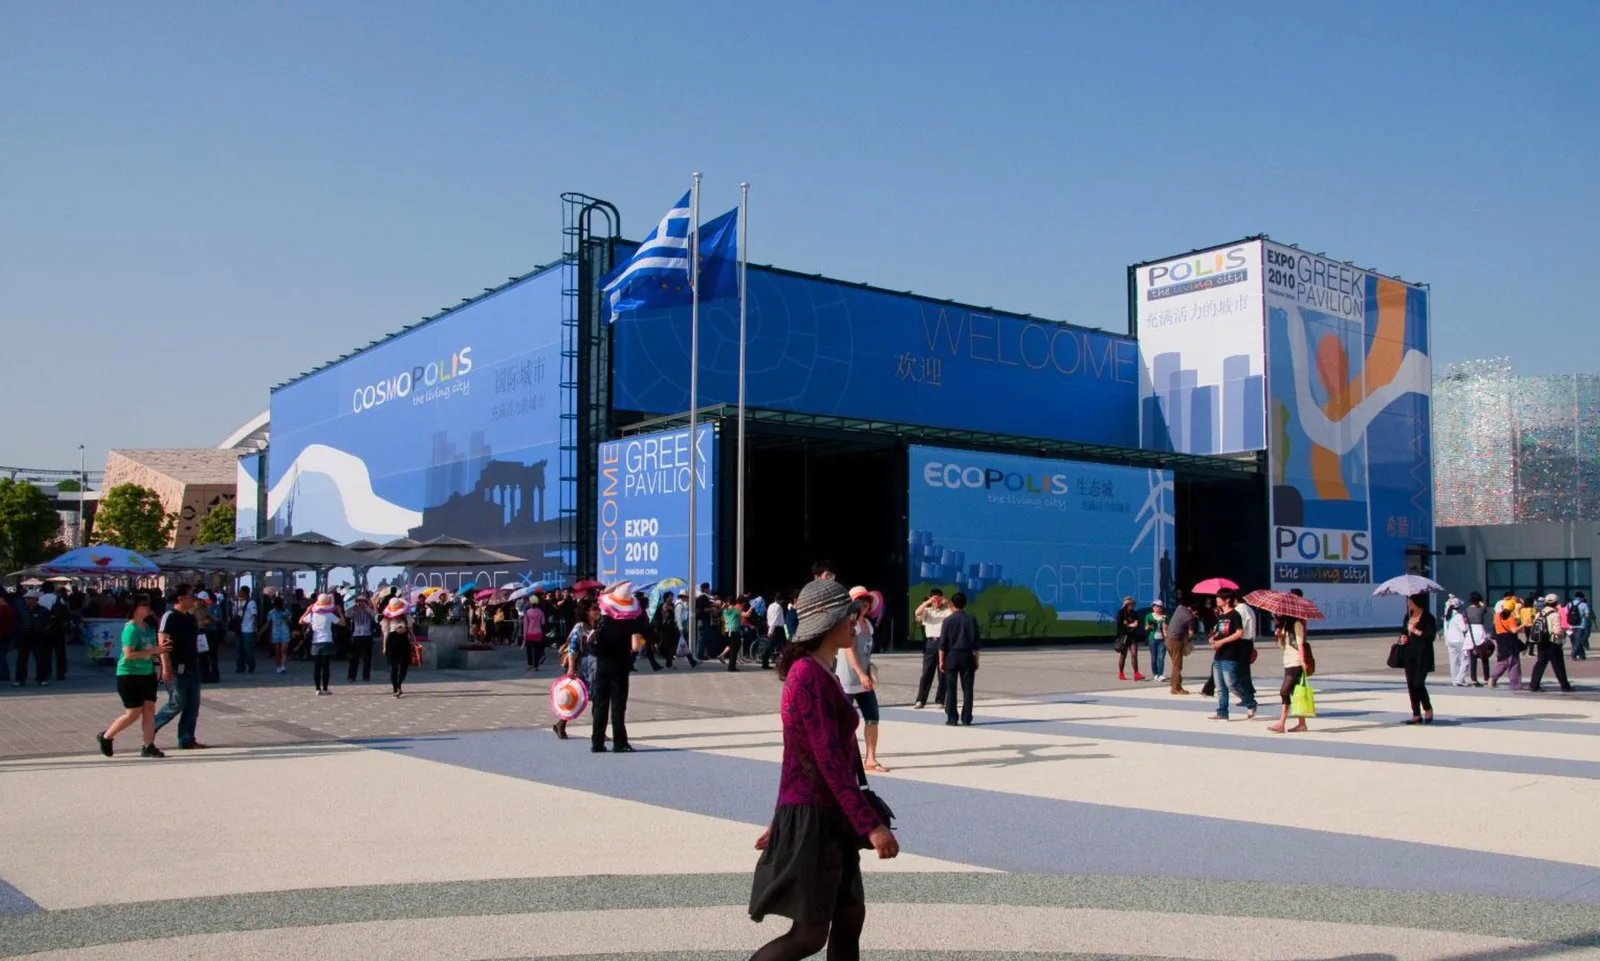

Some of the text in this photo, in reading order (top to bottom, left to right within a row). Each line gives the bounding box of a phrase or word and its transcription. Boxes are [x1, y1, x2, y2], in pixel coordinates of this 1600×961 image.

[1148, 248, 1247, 287] POLIS
[1267, 249, 1295, 270] EXPO
[1151, 288, 1170, 298] the
[1216, 273, 1244, 284] city
[1268, 267, 1295, 290] 2010
[1297, 255, 1363, 299] GREEK
[1297, 282, 1363, 319] PAVILION
[919, 304, 1134, 384] WELCOME
[353, 346, 472, 414] COSMOPOLIS
[895, 351, 942, 385] 欢迎
[625, 430, 706, 474] GREEK
[625, 464, 706, 498] PAVILION
[923, 462, 1068, 495] ECOPOLIS
[624, 518, 658, 537] EXPO
[1276, 527, 1369, 561] POLIS
[625, 541, 658, 562] 2010
[1035, 564, 1152, 604] GREECE
[1279, 564, 1299, 579] the
[1343, 566, 1366, 583] city
